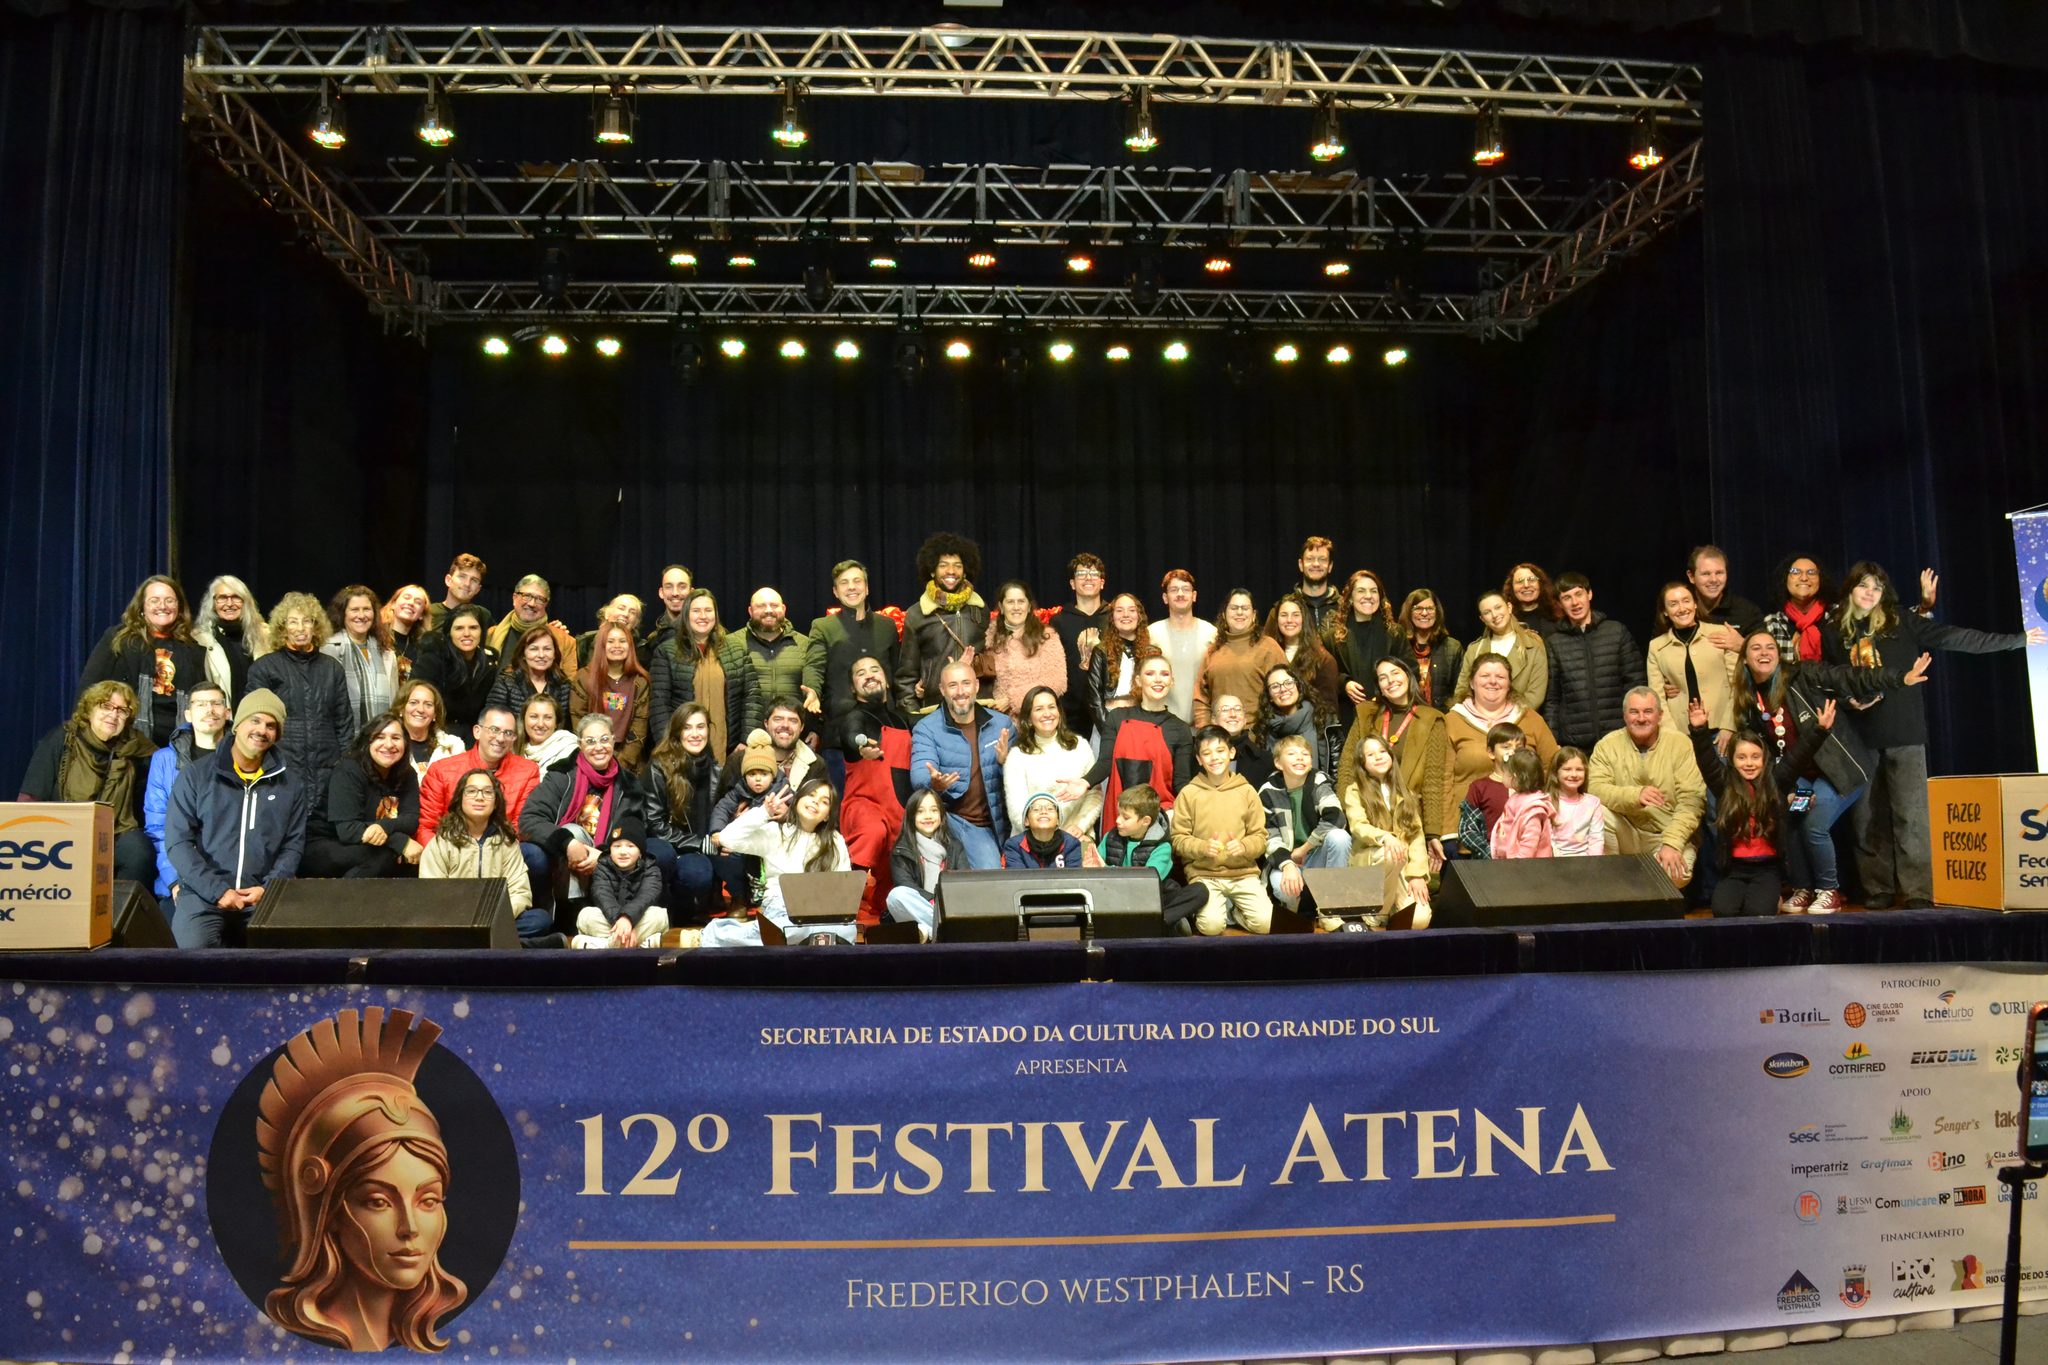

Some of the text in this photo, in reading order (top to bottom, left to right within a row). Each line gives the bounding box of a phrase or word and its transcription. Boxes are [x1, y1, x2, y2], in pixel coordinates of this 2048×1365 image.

[1946, 803, 1981, 824] FAZER
[1943, 831, 1987, 852] PESSOAS
[1946, 859, 1987, 881] FELIZES
[1881, 977, 1941, 989] PATROCÍNIO
[2002, 1001, 2026, 1015] URI
[760, 1017, 1440, 1045] SECRETARIA DE ESTADO DA CULTURA DO RIO GRANDE DO SUL
[1015, 1058, 1128, 1076] APRESENTA
[1828, 1063, 1886, 1075] COTRIFRED
[1900, 1087, 1931, 1097] APOIO
[1933, 1116, 1981, 1134] Senger's
[1994, 1151, 2006, 1159] Cia
[1791, 1161, 1849, 1178] imperatriz
[1861, 1158, 1913, 1172] Grafimax
[1875, 1196, 1937, 1209] Comunicare
[1880, 1228, 1965, 1243] FINANCIAMENTO
[1986, 1275, 1999, 1284] RIO
[2032, 1271, 2044, 1279] DO
[846, 1277, 1049, 1310] FREDERICO
[1060, 1271, 1292, 1304] WESTPHALEN
[1326, 1264, 1365, 1294] RS
[1893, 1282, 1936, 1301] cultura
[1777, 1293, 1821, 1305] FREDERICO
[1778, 1302, 1821, 1312] WESTPHALEN
